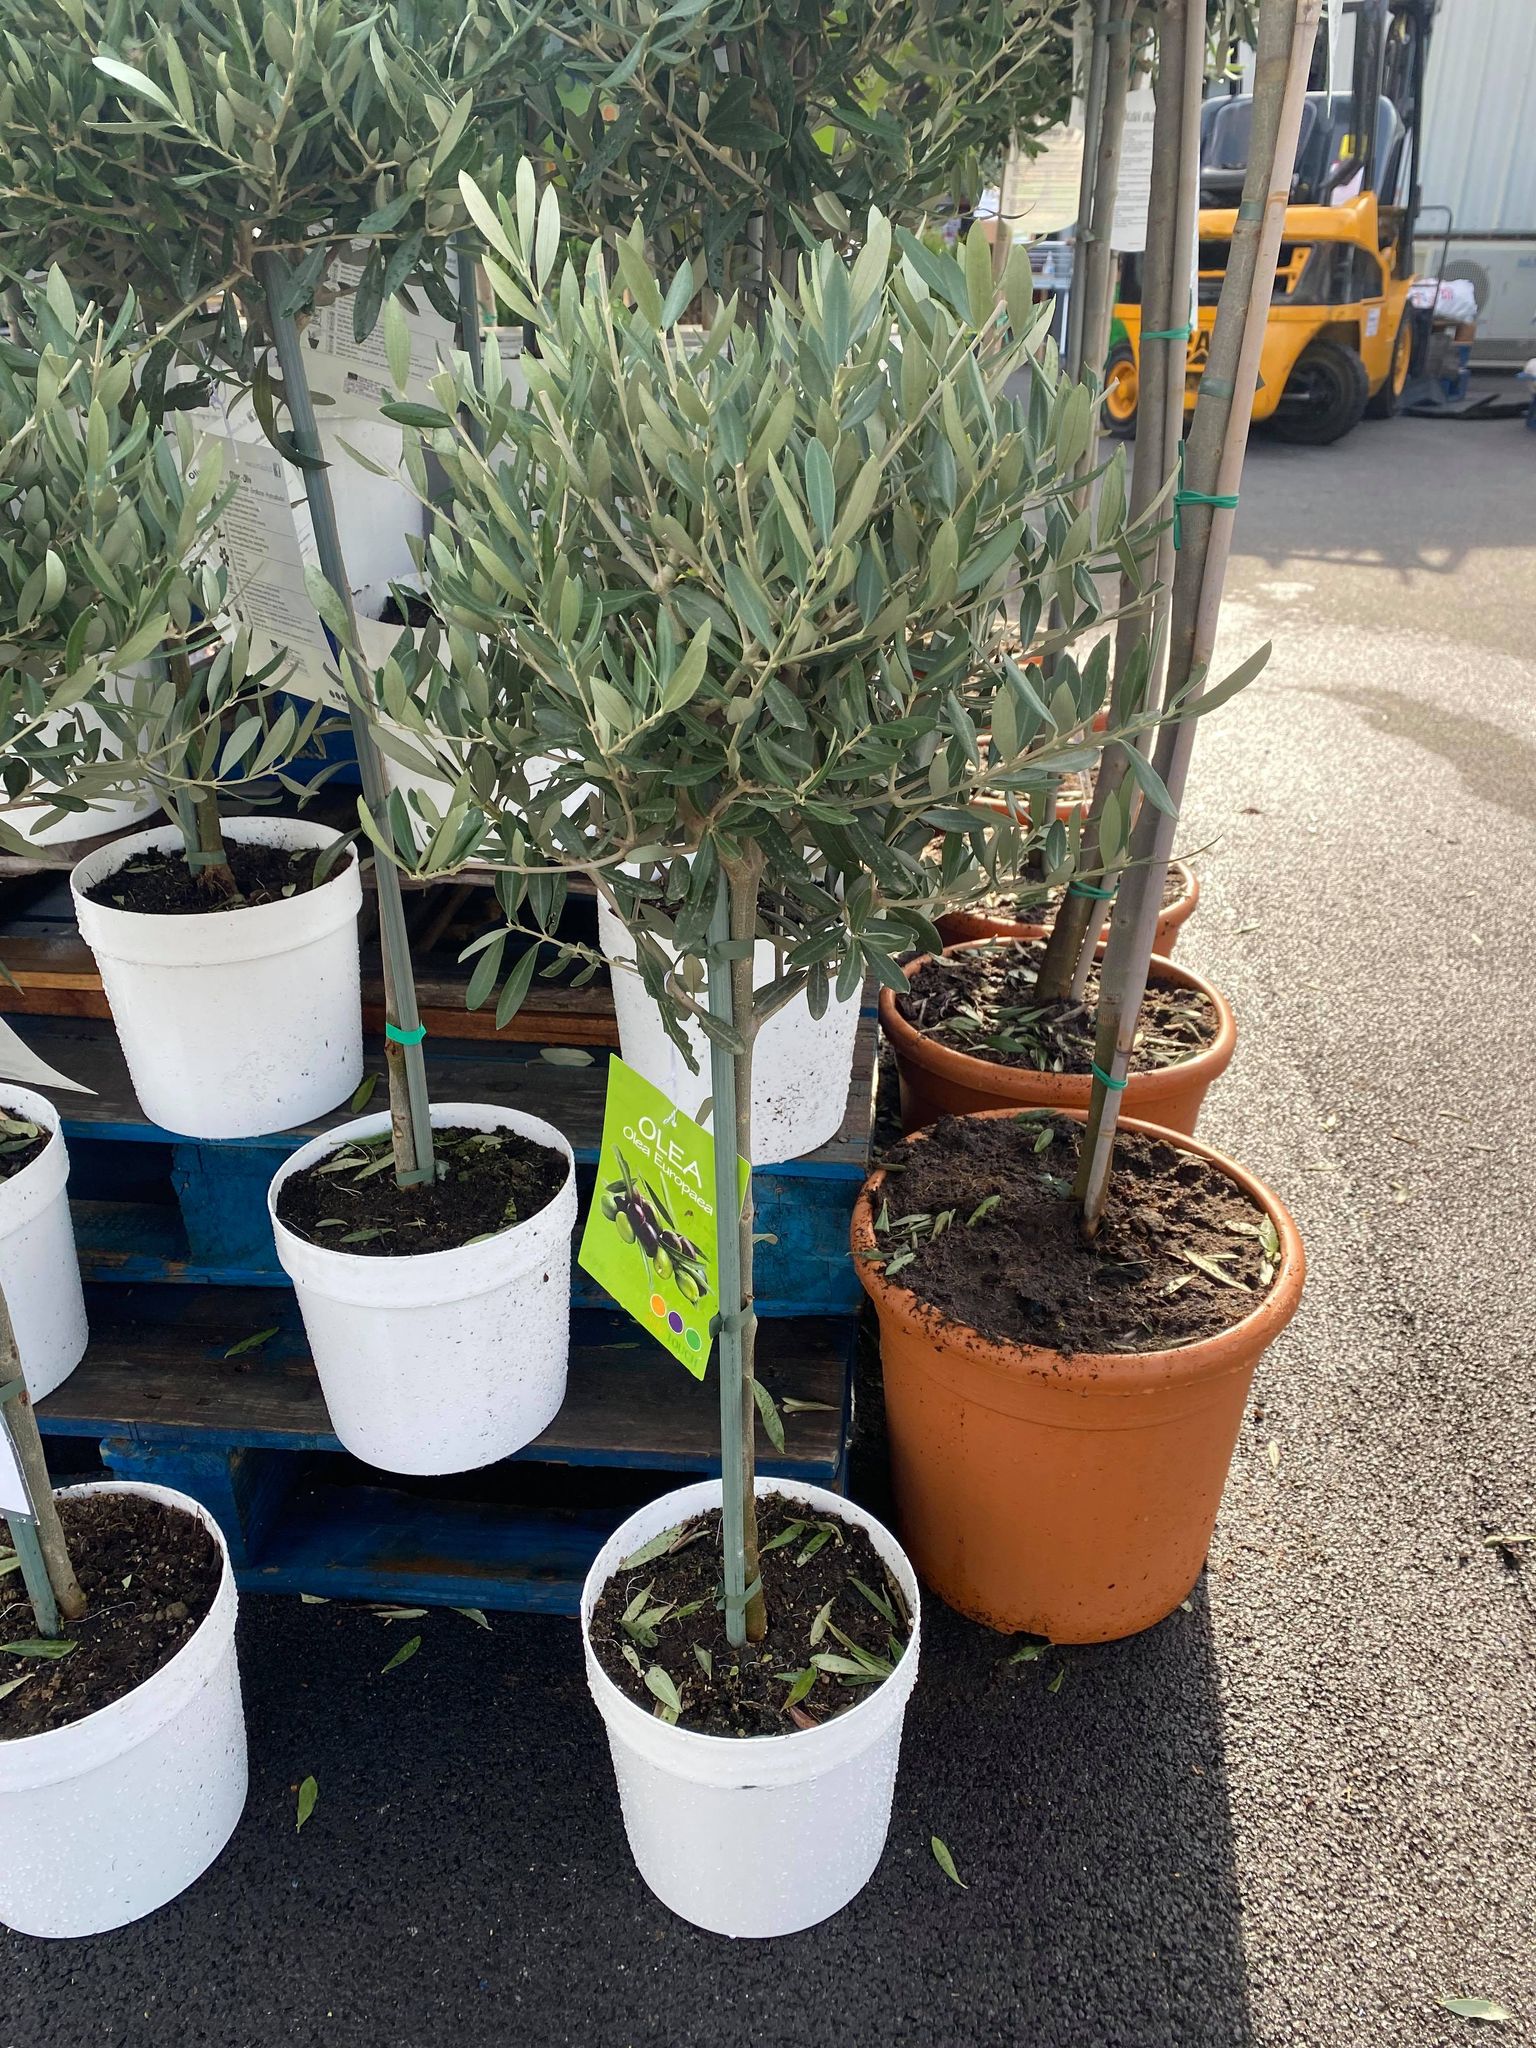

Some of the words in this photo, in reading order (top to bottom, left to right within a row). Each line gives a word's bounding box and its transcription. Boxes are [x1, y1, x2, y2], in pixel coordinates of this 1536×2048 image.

[623, 1126, 651, 1158] Olea
[654, 1151, 714, 1216] Europaea
[638, 1116, 702, 1189] OLEA
